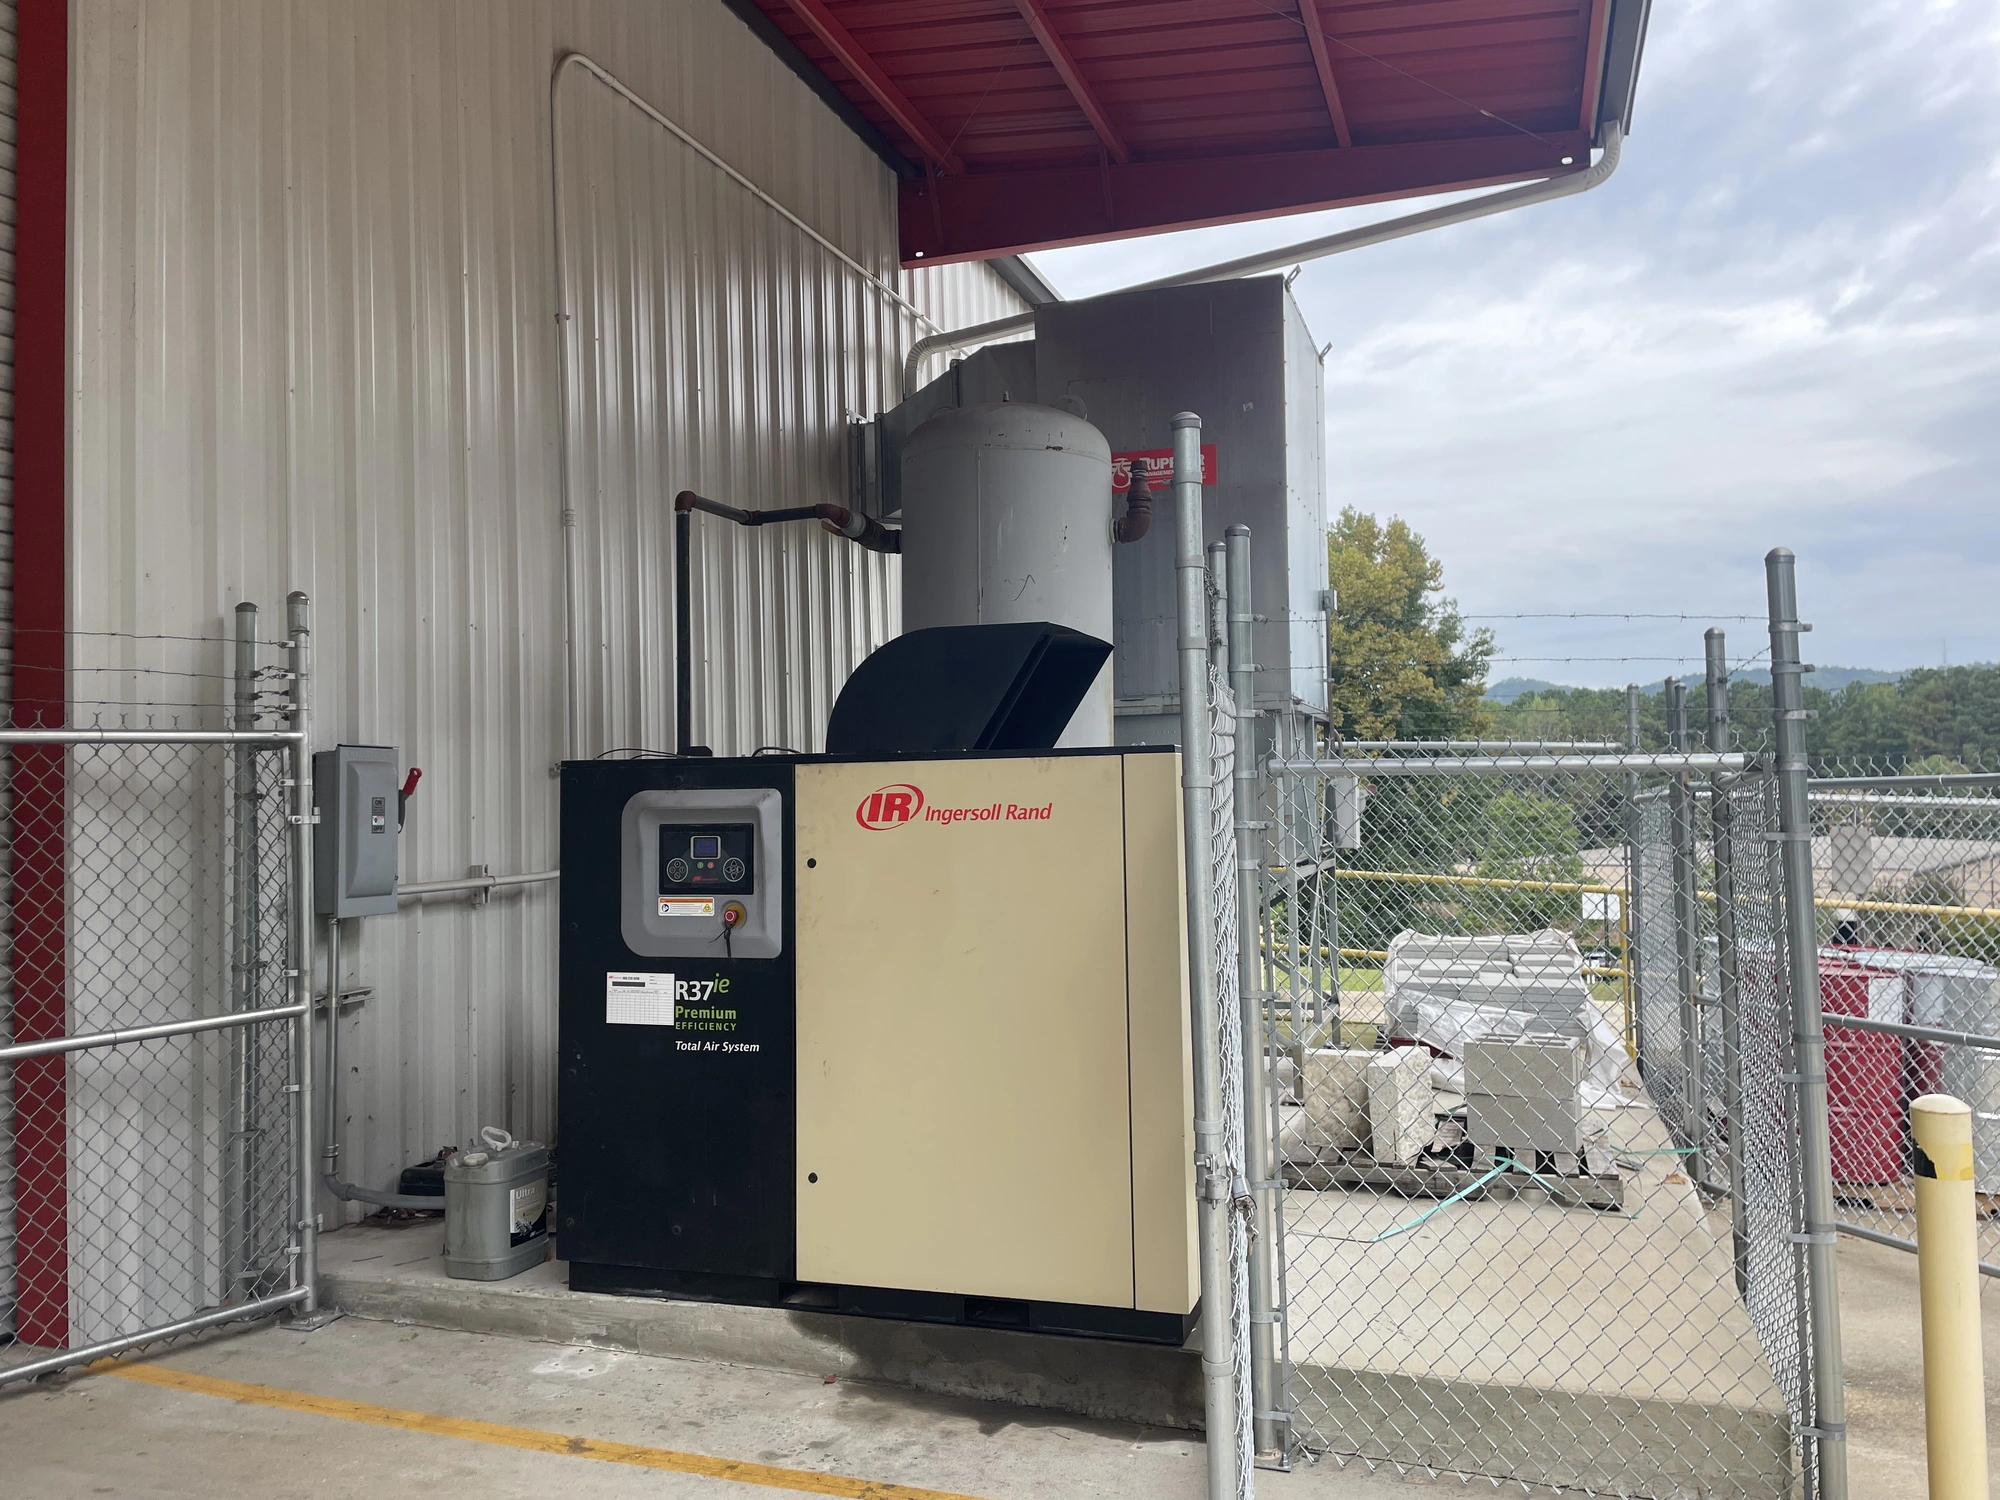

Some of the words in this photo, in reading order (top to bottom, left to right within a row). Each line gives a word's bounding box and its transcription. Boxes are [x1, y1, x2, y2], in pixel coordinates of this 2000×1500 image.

[867, 792, 912, 822] IR
[925, 803, 1001, 825] Ingersoll
[1005, 802, 1053, 821] Rand
[675, 1005, 737, 1020] Premium
[675, 1021, 737, 1031] EFFICIENCY
[675, 1040, 701, 1051] Total
[703, 1041, 720, 1051] Air
[722, 1041, 760, 1053] System
[516, 1188, 535, 1199] Ultra
